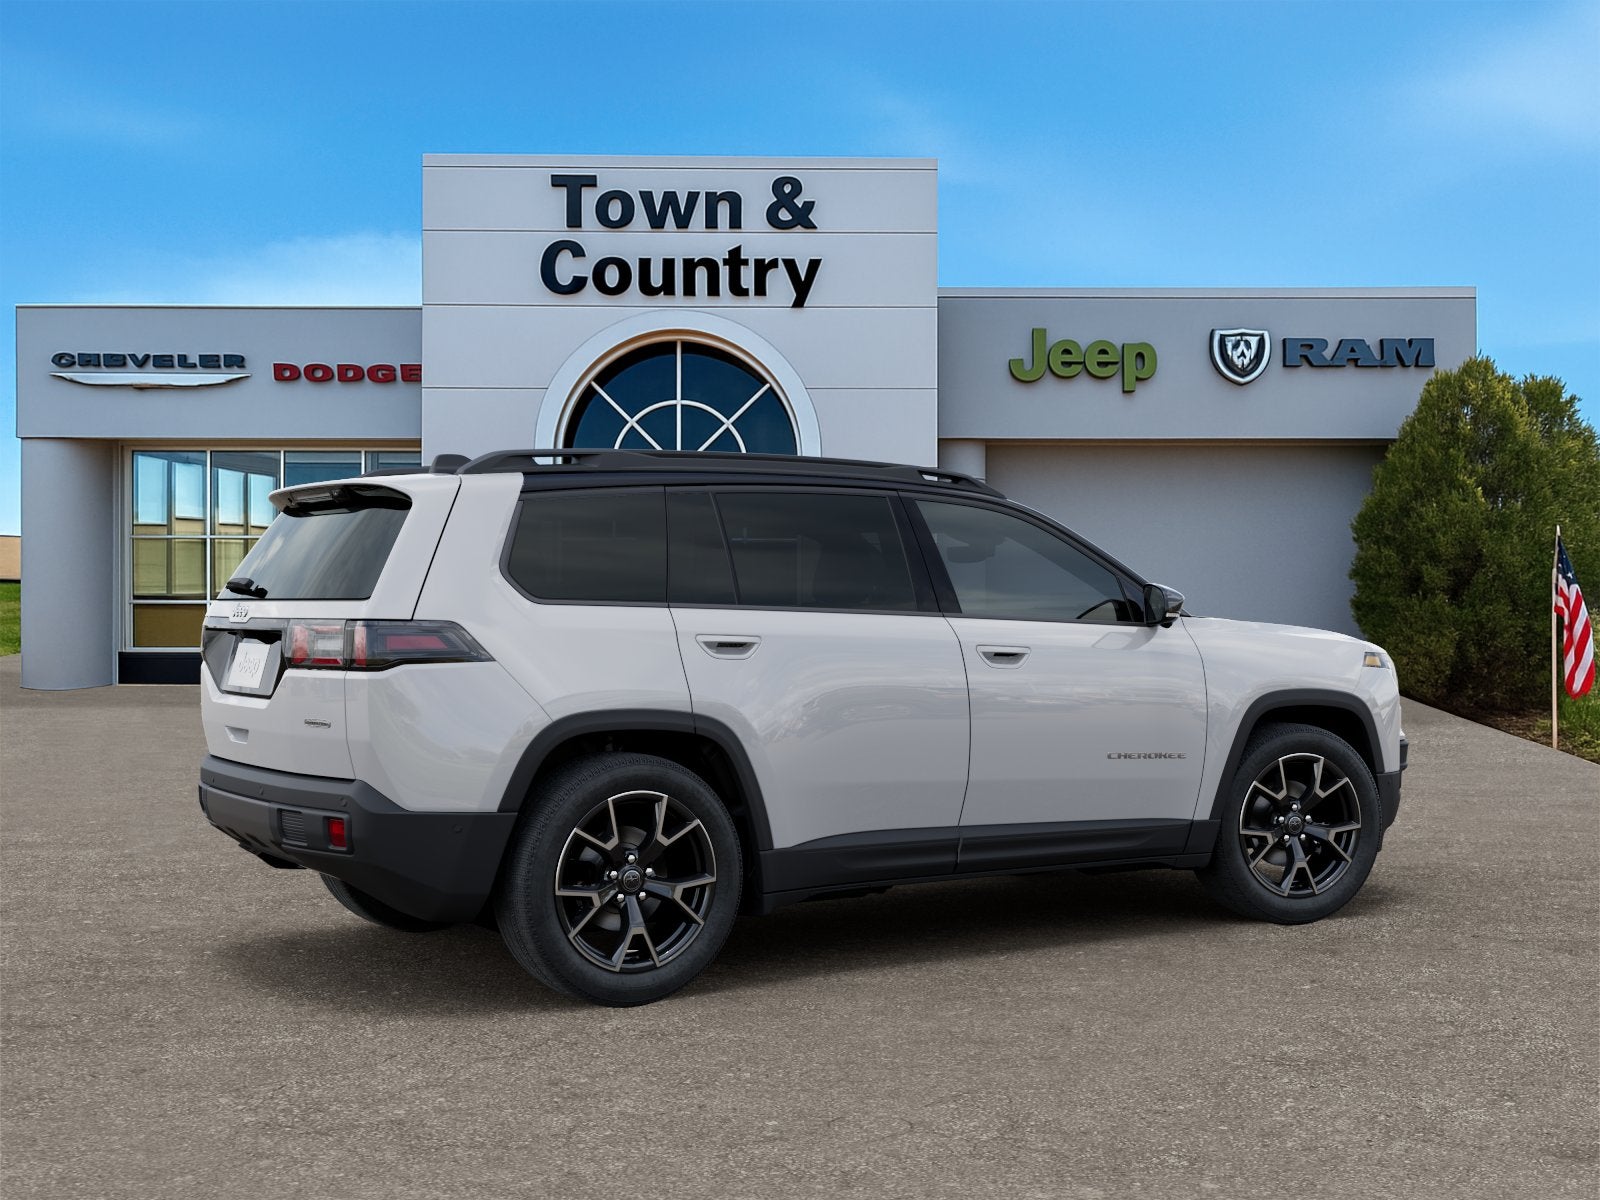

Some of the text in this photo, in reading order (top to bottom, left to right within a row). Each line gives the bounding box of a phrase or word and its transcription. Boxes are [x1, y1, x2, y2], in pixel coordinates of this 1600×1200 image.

[551, 174, 818, 229] Town &
[540, 239, 822, 308] Country
[273, 363, 422, 383] DODGE
[1009, 328, 1157, 393] Jeep
[1283, 338, 1435, 367] RAM
[1107, 752, 1188, 760] CHEROKEE
